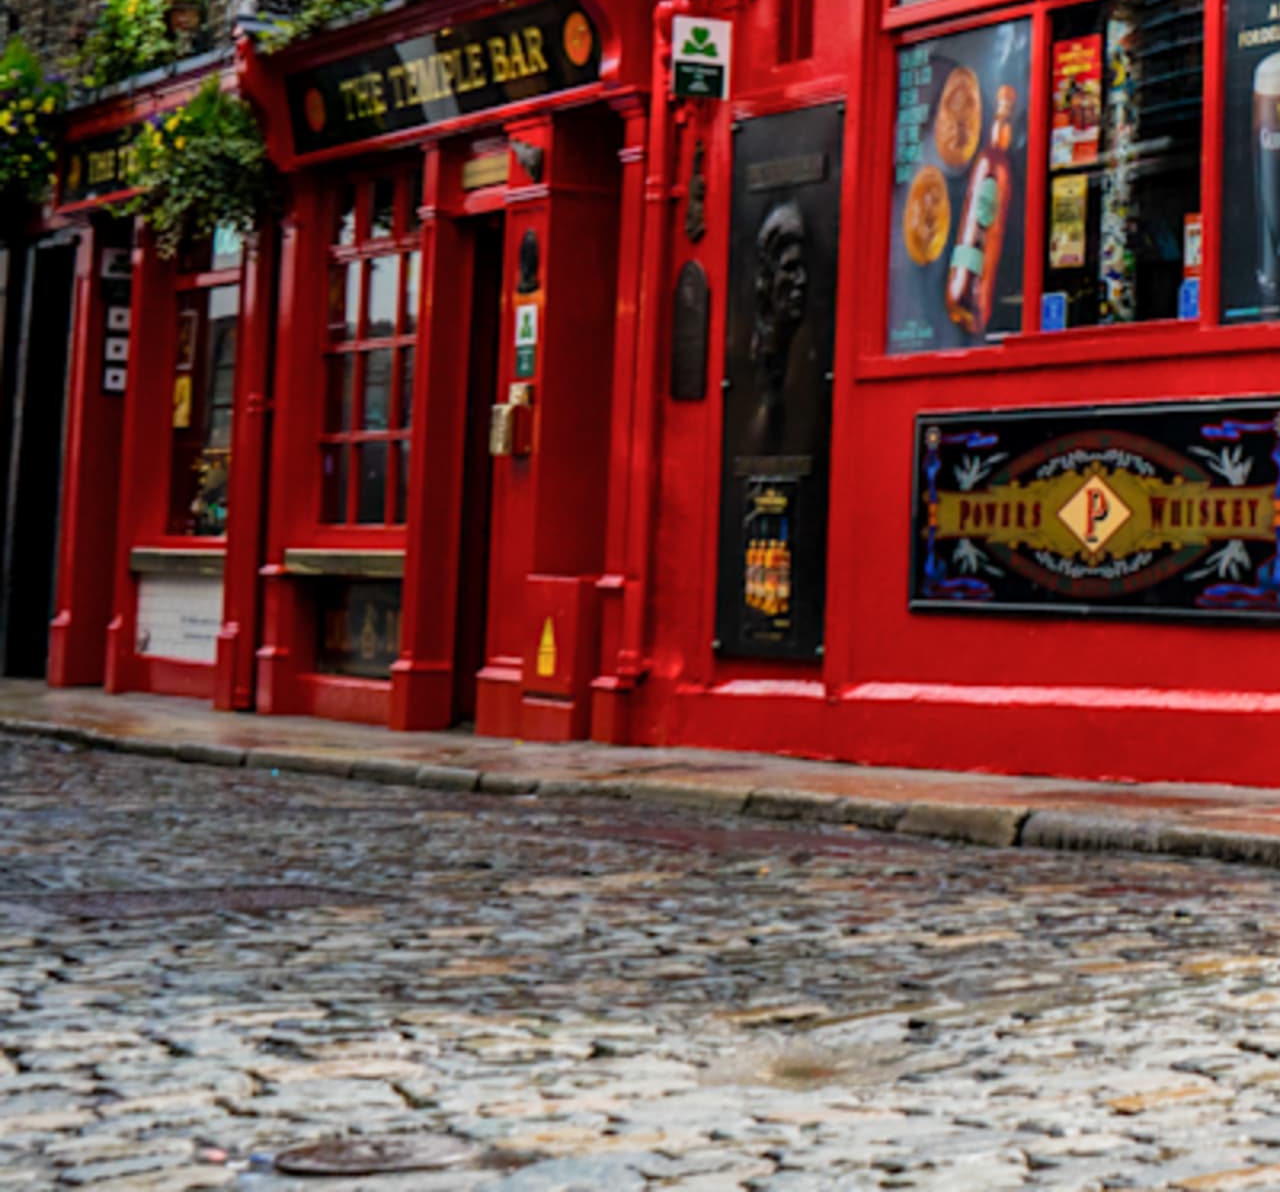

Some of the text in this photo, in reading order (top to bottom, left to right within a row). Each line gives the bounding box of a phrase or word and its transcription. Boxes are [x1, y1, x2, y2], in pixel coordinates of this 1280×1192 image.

[1268, 3, 1278, 19] A
[339, 69, 388, 122] THE
[387, 41, 488, 110] TEMPLE
[487, 25, 549, 84] BAR
[1085, 486, 1109, 543] P
[1147, 496, 1260, 532] WHISKEY
